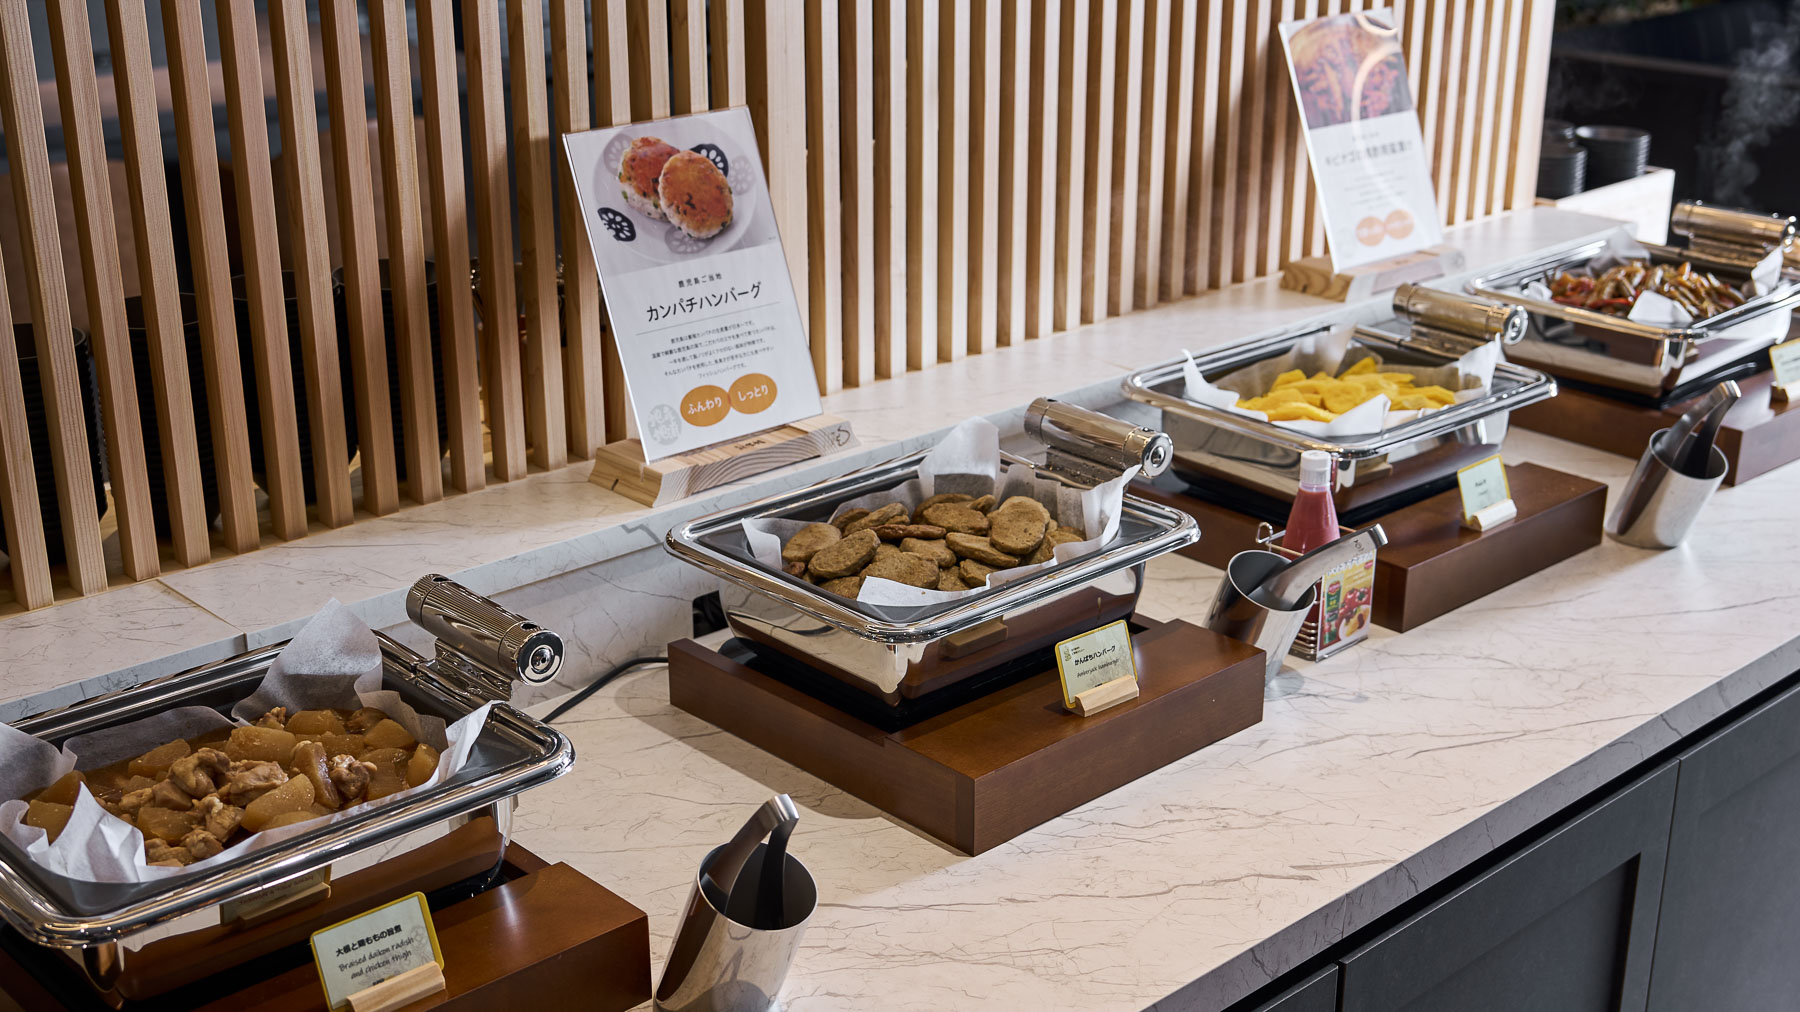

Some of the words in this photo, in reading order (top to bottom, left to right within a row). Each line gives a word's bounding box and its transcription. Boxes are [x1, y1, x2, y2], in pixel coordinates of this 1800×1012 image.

[678, 273, 722, 288] 鹿児島ご当地
[646, 281, 761, 322] カンパチハンバーグ
[738, 384, 769, 402] しっとり
[688, 397, 722, 415] ふんわり
[338, 954, 367, 972] Braised
[368, 947, 391, 961] daikon
[391, 936, 415, 951] radish
[351, 967, 364, 979] and
[365, 958, 391, 974] chicken
[391, 949, 412, 962] thigh
